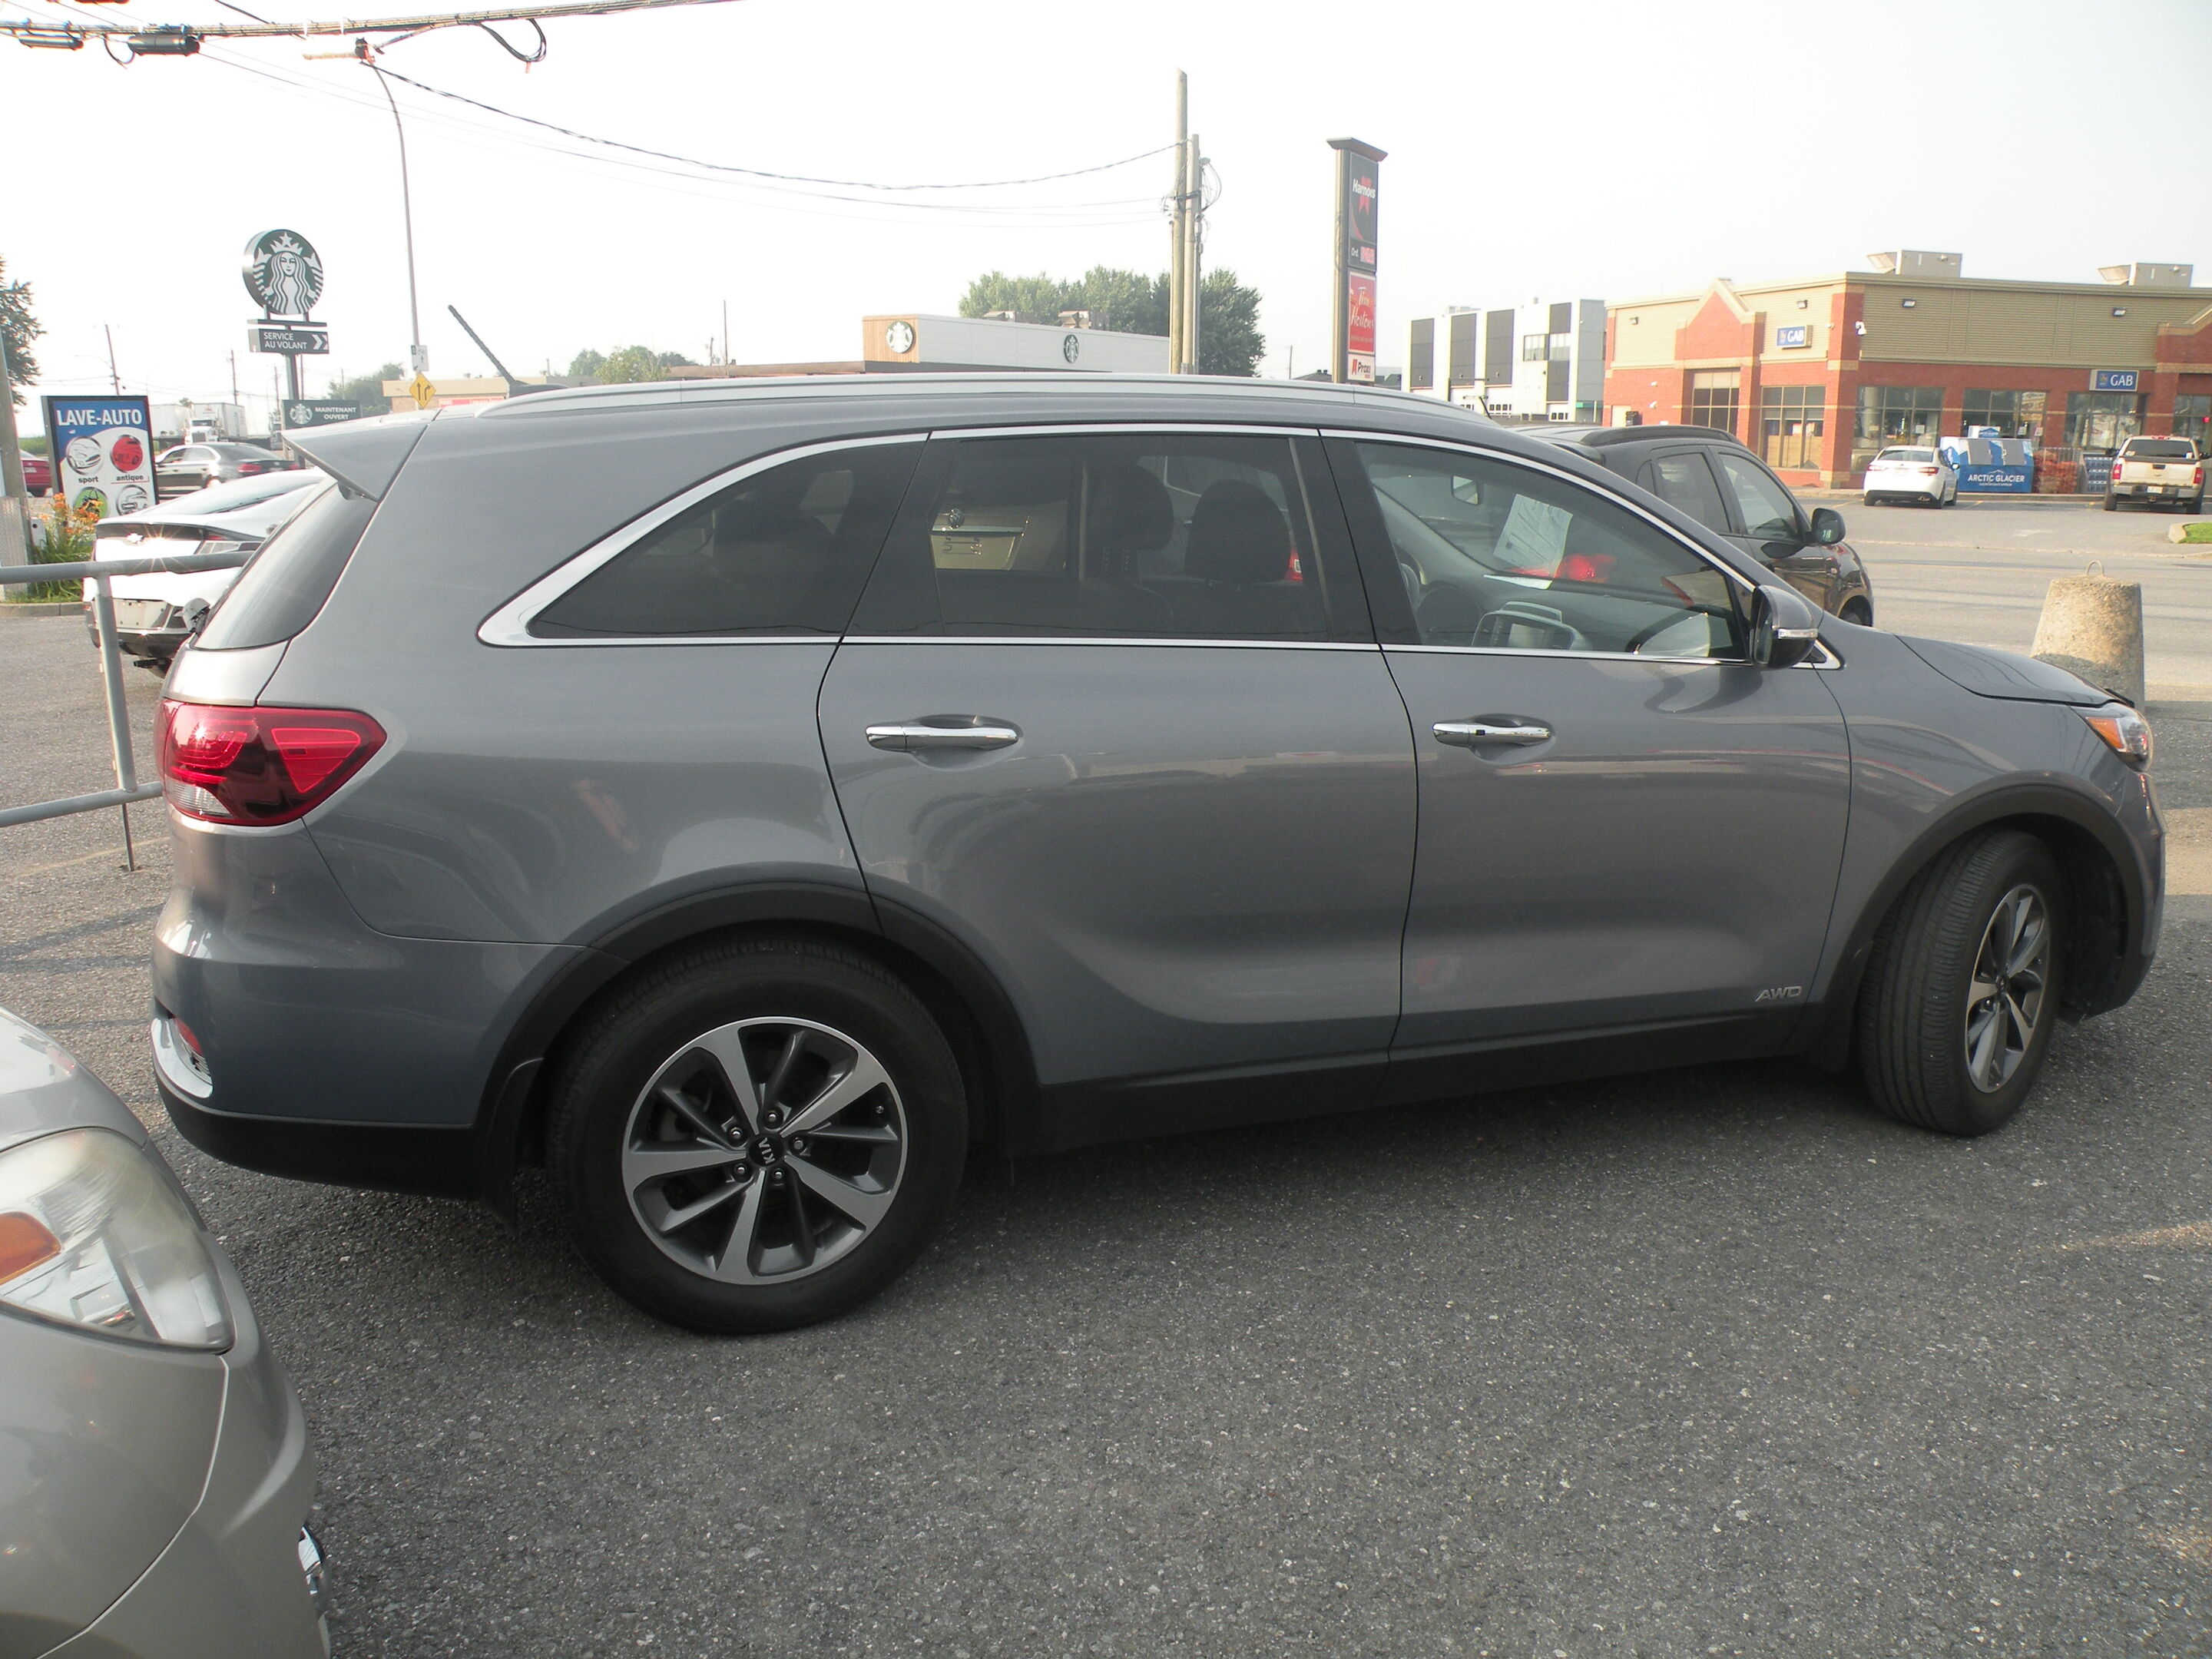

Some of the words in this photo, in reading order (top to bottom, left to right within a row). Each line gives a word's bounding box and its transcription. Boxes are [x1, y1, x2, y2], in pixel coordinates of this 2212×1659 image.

[1358, 286, 1369, 307] Tim
[263, 332, 293, 340] SERVICE
[1787, 329, 1804, 343] GAB
[276, 341, 307, 349] VOLANT
[2110, 374, 2133, 386] GAB
[56, 409, 143, 426] LAVE-AUTO
[78, 475, 99, 484] sport
[116, 474, 144, 482] antique
[1754, 985, 1802, 1002] AWD
[759, 1137, 775, 1164] KIA
